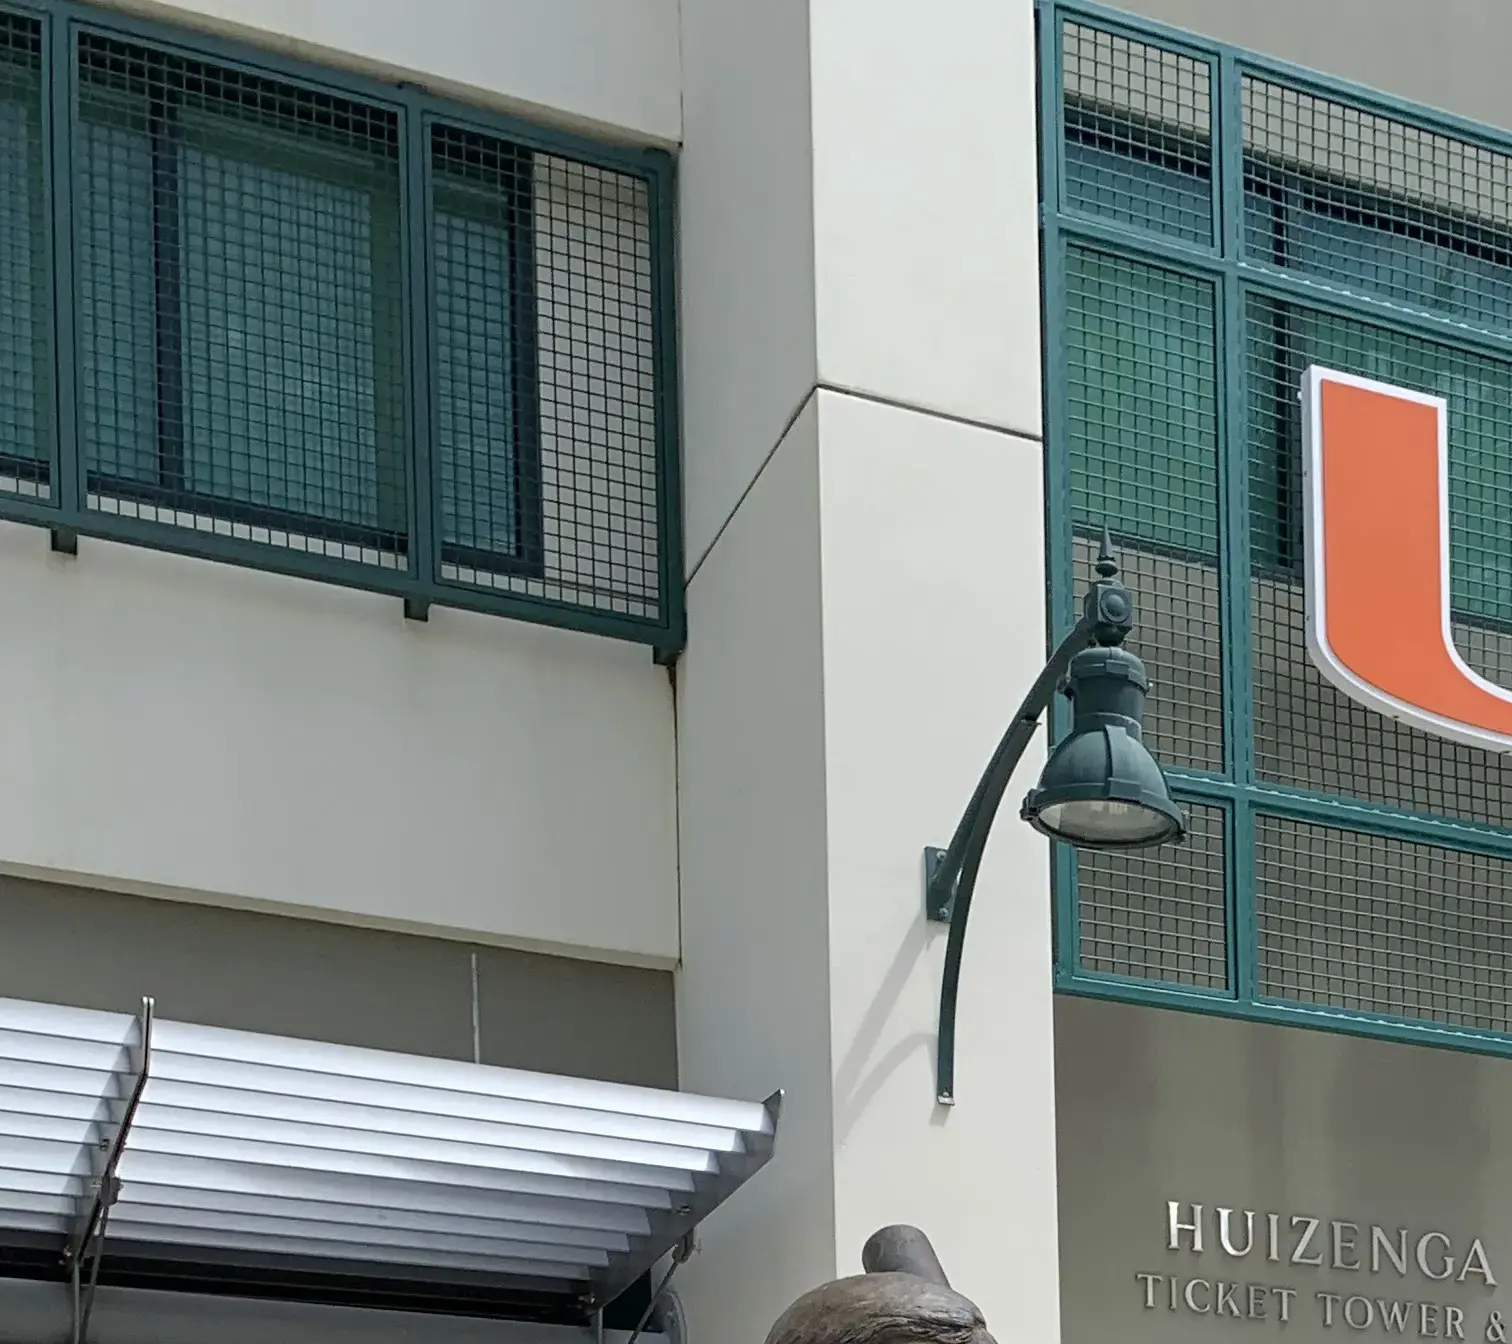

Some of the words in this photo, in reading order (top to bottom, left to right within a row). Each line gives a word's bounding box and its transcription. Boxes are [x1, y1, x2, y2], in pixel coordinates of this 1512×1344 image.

[1166, 1199, 1498, 1287] HUIZENGA
[1135, 1272, 1297, 1322] TICKET
[1315, 1292, 1467, 1340] TOWER
[1486, 1310, 1508, 1344] &
